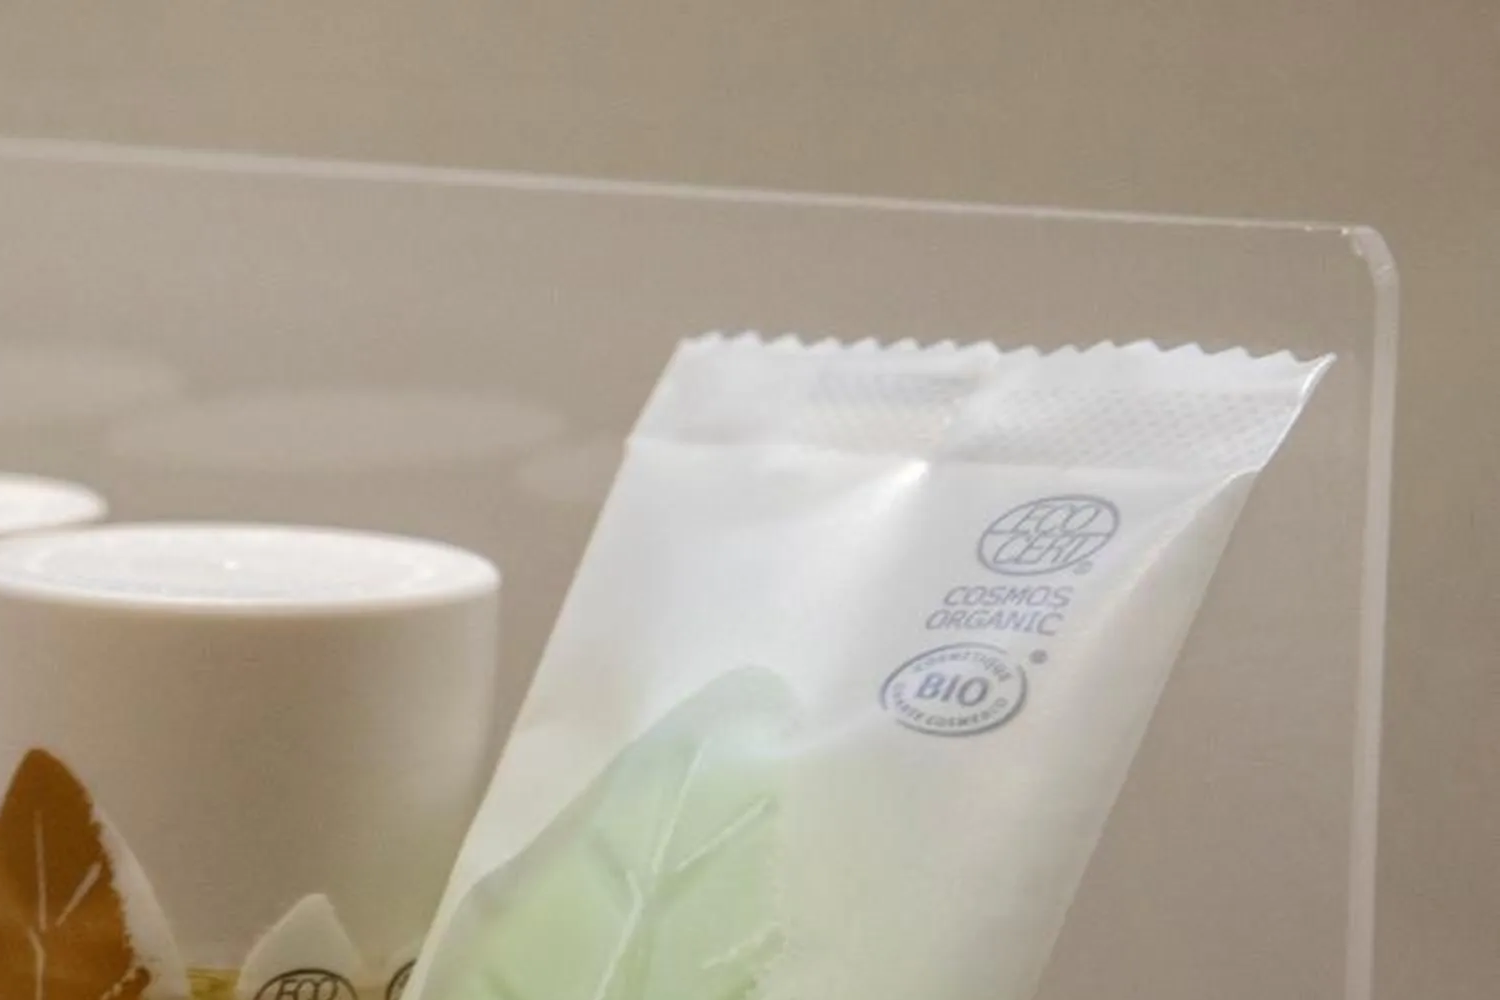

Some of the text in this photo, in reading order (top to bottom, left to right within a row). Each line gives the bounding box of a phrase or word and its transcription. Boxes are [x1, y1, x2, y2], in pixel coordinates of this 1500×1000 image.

[1010, 503, 1102, 533] ECO
[943, 584, 1075, 608] COSMOS
[924, 608, 1064, 637] ORGANIC
[914, 671, 991, 708] BIO
